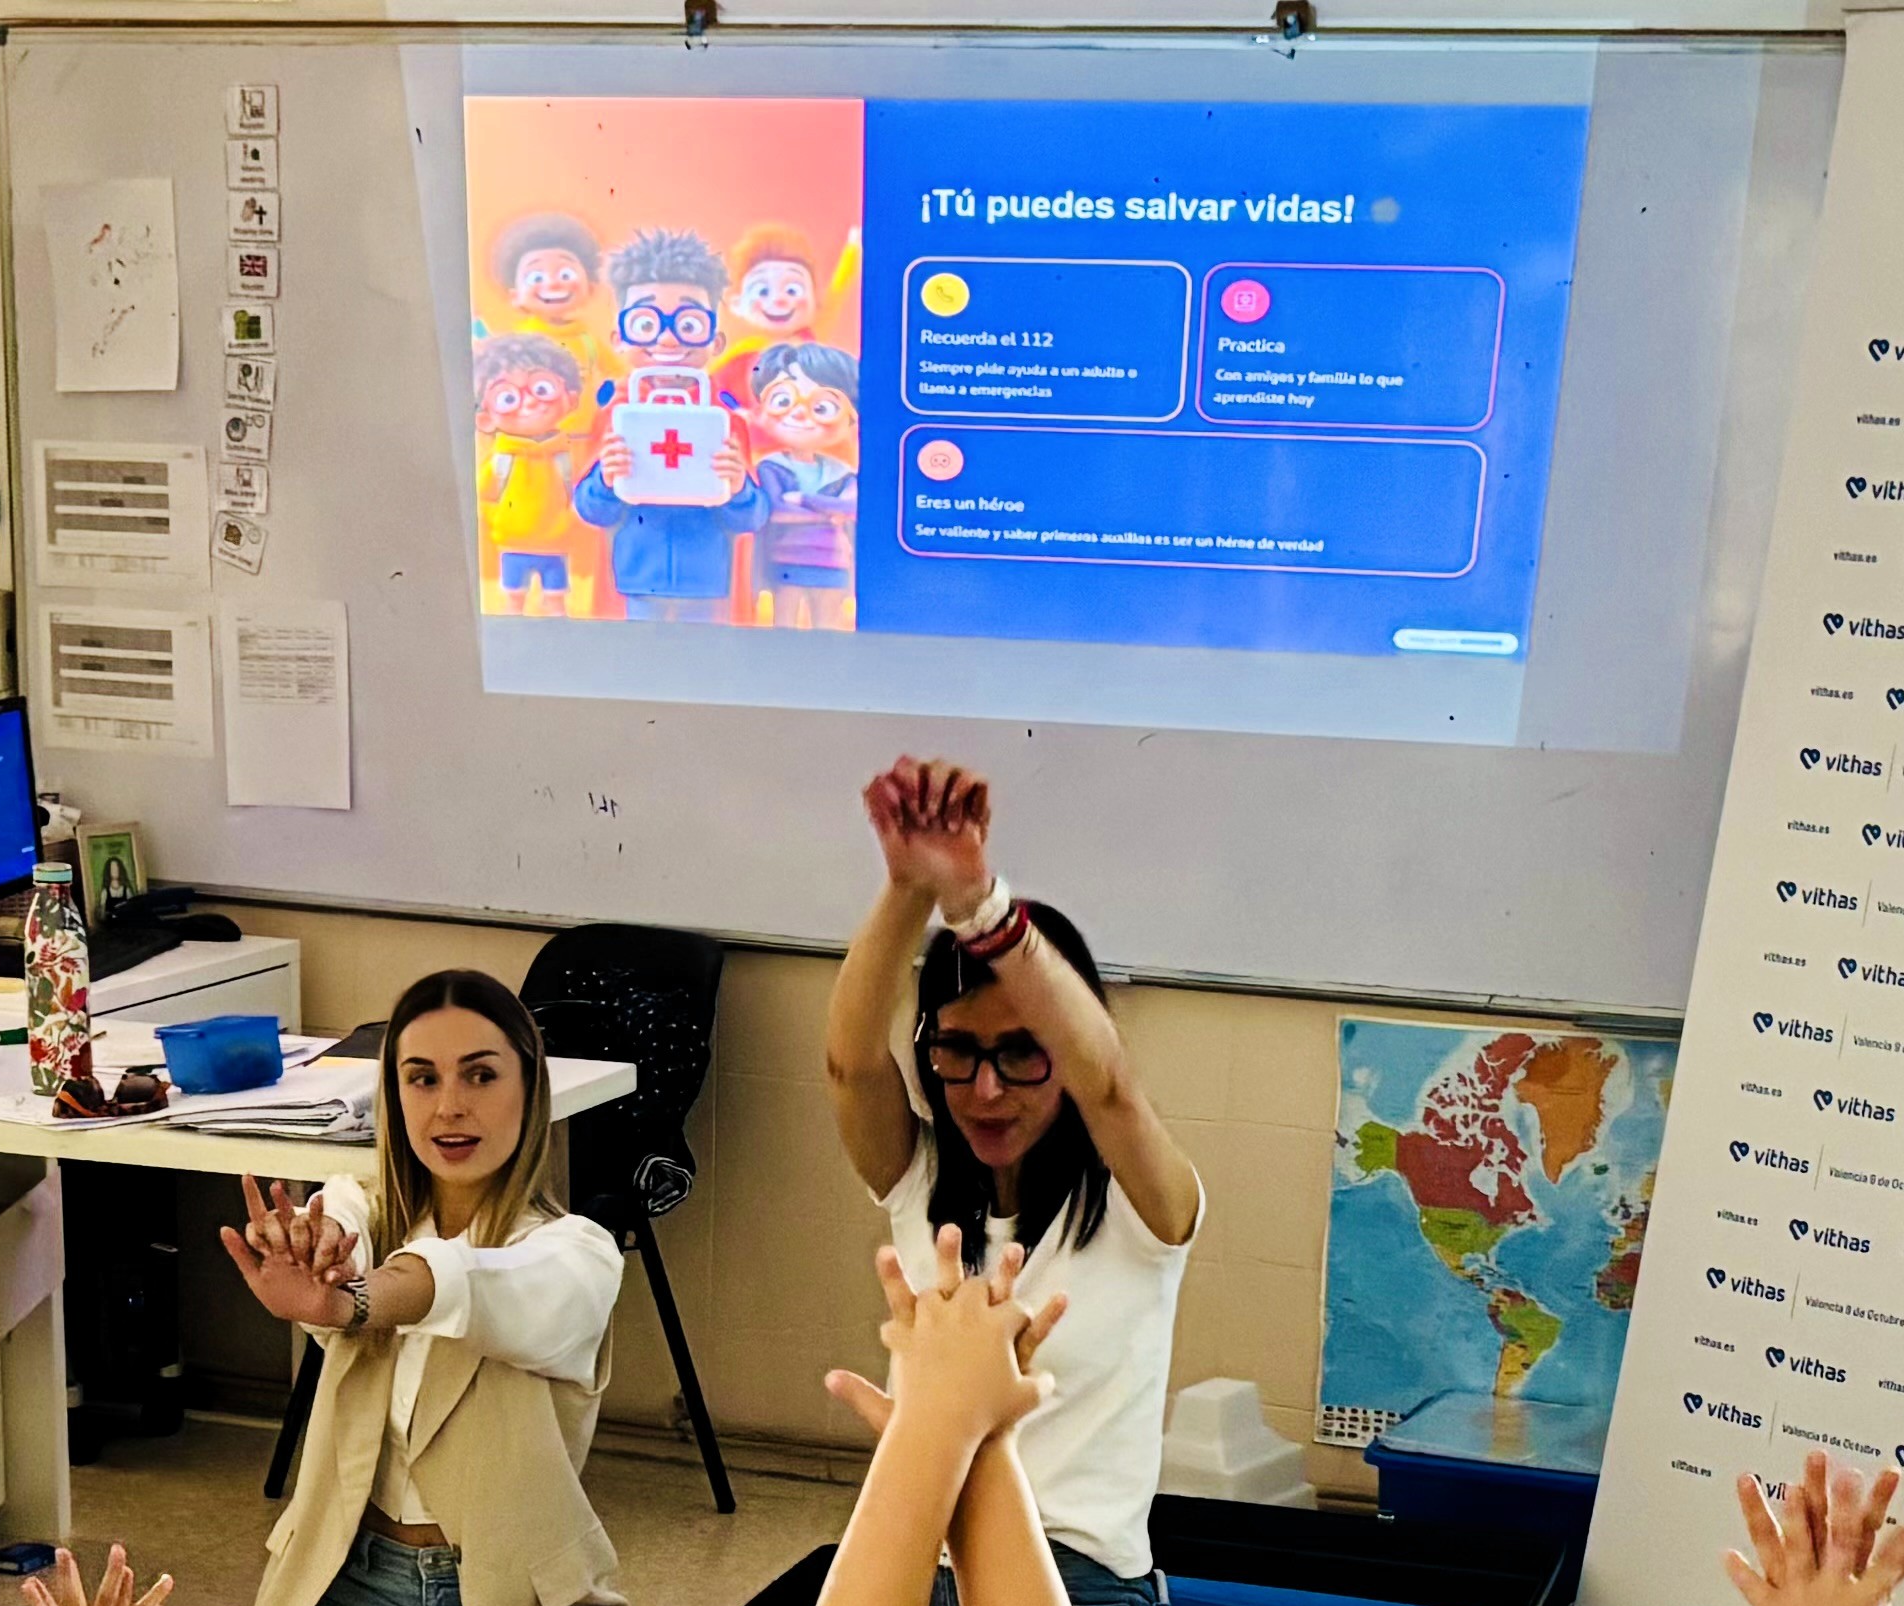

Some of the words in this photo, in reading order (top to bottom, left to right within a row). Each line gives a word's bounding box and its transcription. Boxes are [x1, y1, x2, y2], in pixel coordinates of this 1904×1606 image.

[922, 188, 975, 223] ¡Tú
[987, 190, 1115, 224] puedes
[1125, 192, 1237, 221] salvar
[1244, 193, 1355, 223] vidas!
[920, 329, 998, 346] Recuerda
[1000, 331, 1017, 346] el
[1021, 331, 1054, 348] 112
[1218, 337, 1285, 353] Practica
[919, 360, 973, 376] Siempre
[976, 363, 1005, 376] pide
[1007, 365, 1047, 377] ayuda
[1061, 368, 1080, 376] un
[1215, 369, 1243, 382] Con
[1245, 371, 1294, 386] amigos
[1297, 374, 1306, 386] y
[1308, 371, 1356, 384] familia
[1359, 373, 1374, 385] lo
[1376, 376, 1404, 388] que
[919, 382, 955, 395] llama
[970, 386, 1052, 399] emergencias
[1213, 392, 1285, 405] aprendiste
[1288, 393, 1315, 408] hoy
[916, 495, 951, 509] Eres
[954, 500, 975, 510] un
[979, 497, 1024, 512] héroe
[914, 524, 937, 537] Ser
[938, 526, 990, 540] valiente
[1003, 528, 1038, 541] saber
[1040, 530, 1099, 544] primeros
[1257, 538, 1275, 550] de
[1277, 539, 1324, 552] verdad
[1826, 754, 1882, 776] vithas
[1802, 887, 1858, 910] vithas
[1778, 1019, 1833, 1043] vithas
[1837, 1097, 1895, 1122] vithas
[1754, 1148, 1809, 1173] vithas
[1813, 1228, 1870, 1253] vithas
[1731, 1276, 1785, 1302] vithas
[1790, 1356, 1846, 1383] vithas
[1707, 1402, 1762, 1428] vithas
